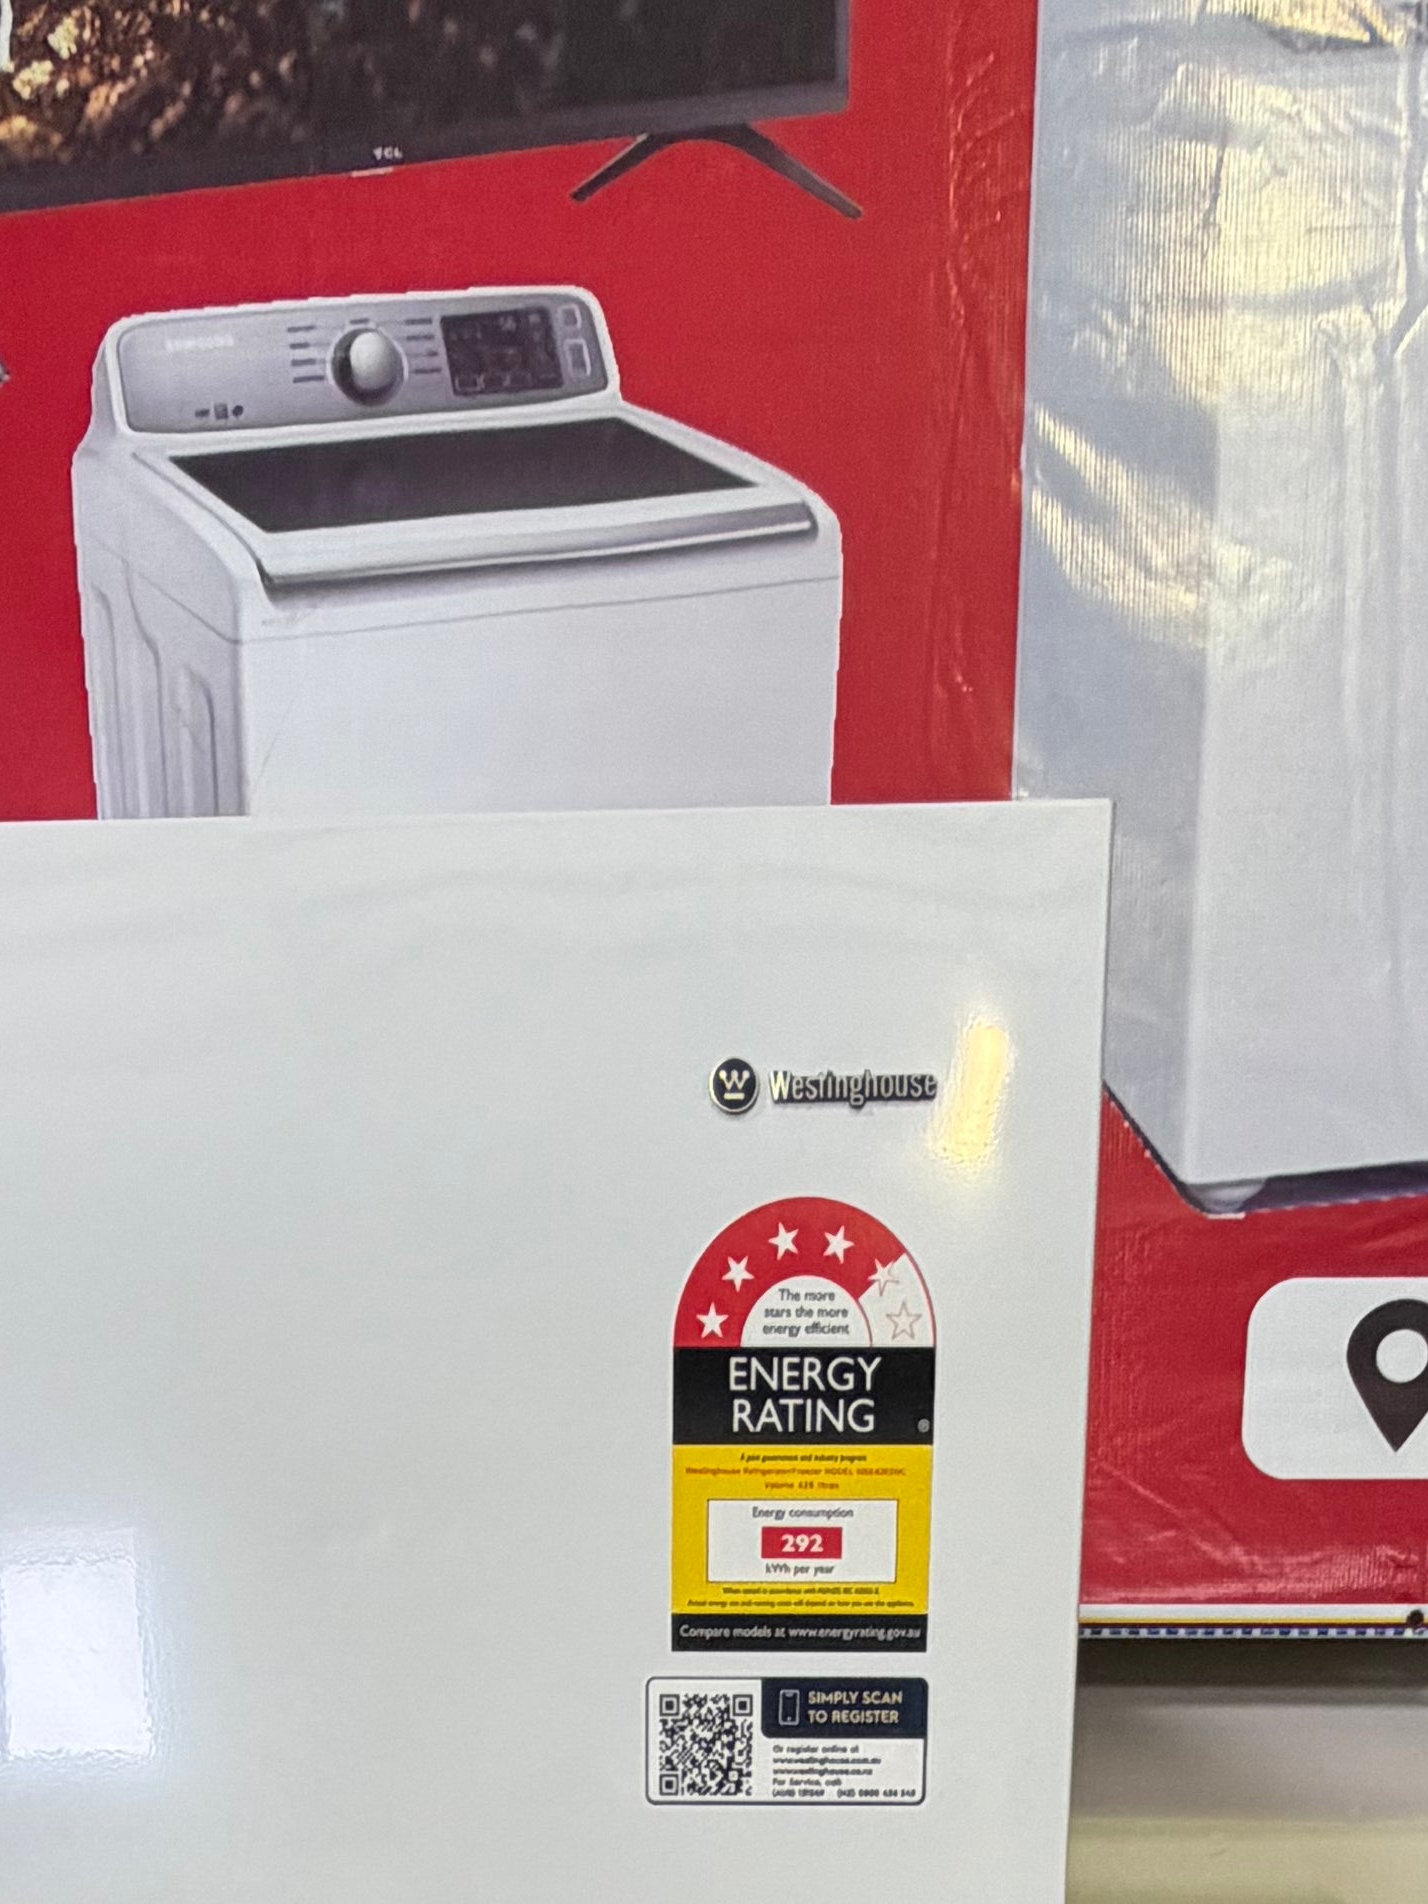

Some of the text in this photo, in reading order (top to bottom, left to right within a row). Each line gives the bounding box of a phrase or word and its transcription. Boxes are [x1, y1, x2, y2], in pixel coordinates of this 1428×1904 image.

[769, 1070, 939, 1109] Westinghouse
[778, 1288, 835, 1302] The more
[764, 1305, 849, 1319] stars the more
[762, 1322, 850, 1339] energy efficient
[729, 1356, 882, 1392] ENERGY
[732, 1399, 875, 1433] RATING
[752, 1506, 854, 1521] Energy consumption
[781, 1534, 824, 1553] 292
[793, 1565, 810, 1577] per
[813, 1565, 835, 1577] year
[679, 1624, 730, 1640] Compare
[733, 1625, 772, 1638] models
[774, 1626, 786, 1638] at
[808, 1690, 903, 1705] SIMPLY SCAN
[808, 1709, 899, 1724] TO REGISTER
